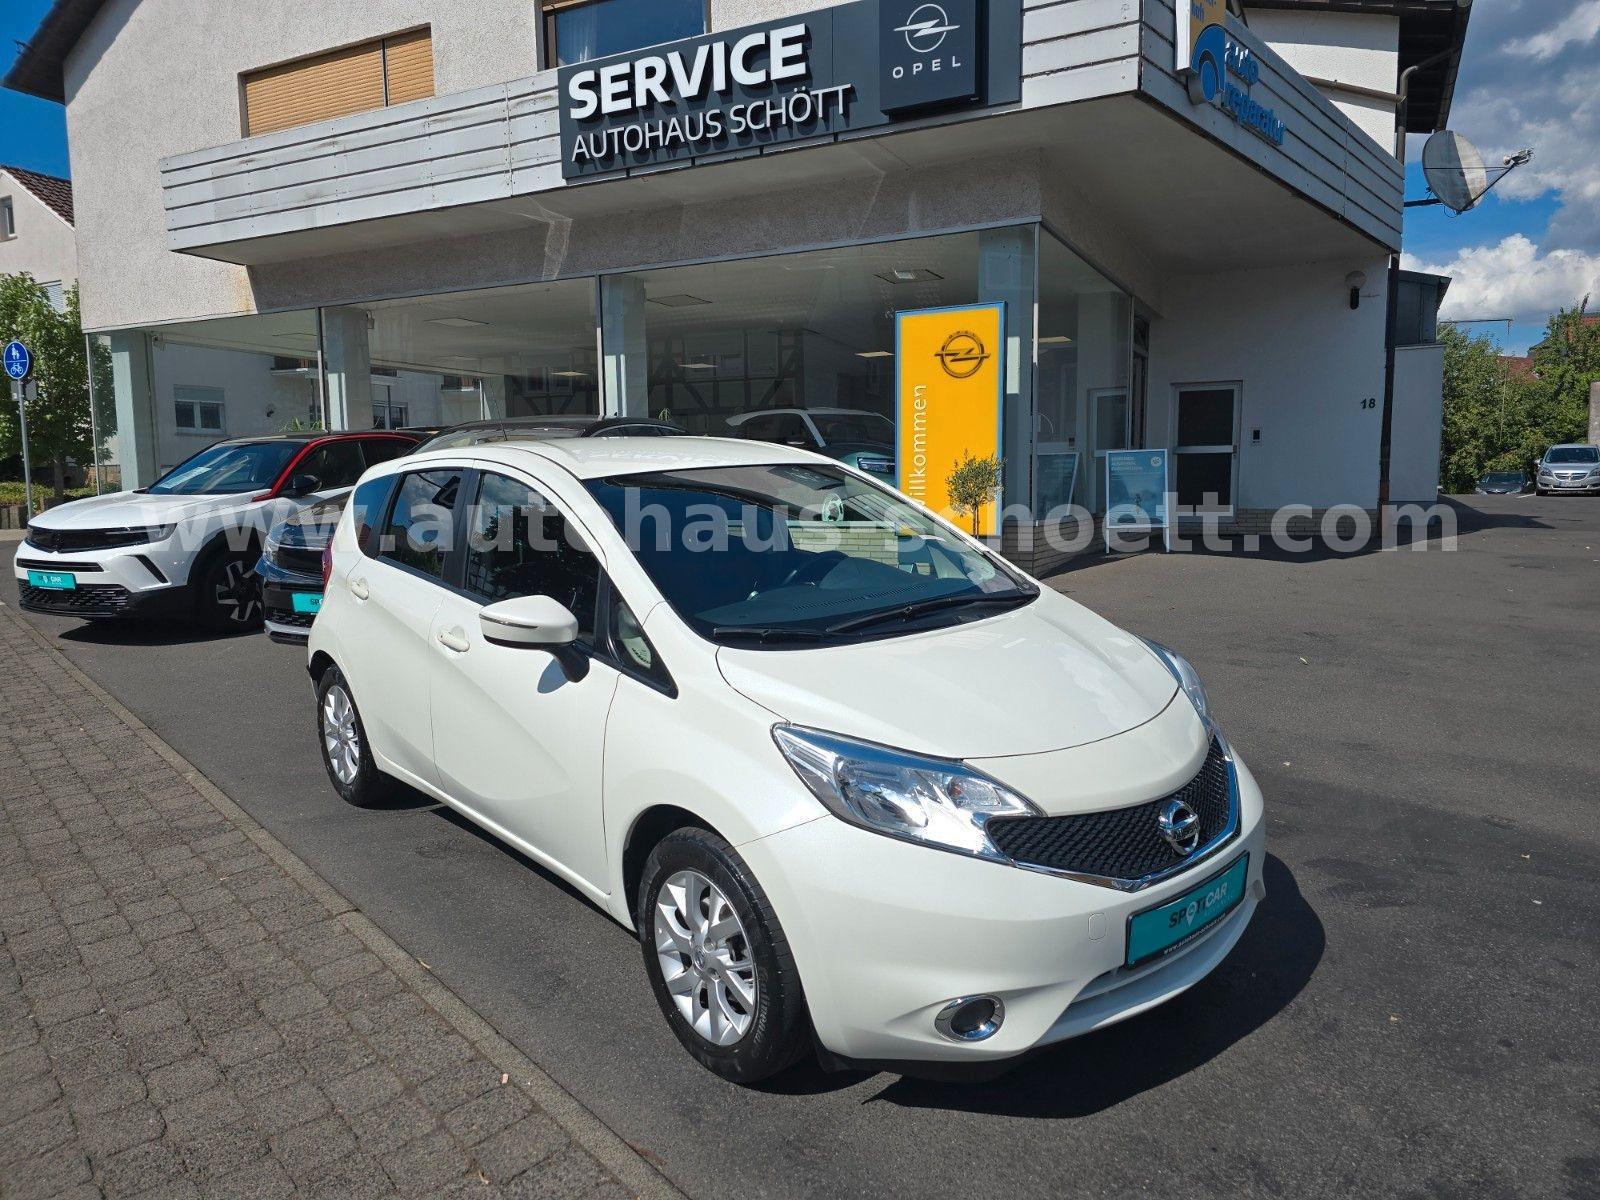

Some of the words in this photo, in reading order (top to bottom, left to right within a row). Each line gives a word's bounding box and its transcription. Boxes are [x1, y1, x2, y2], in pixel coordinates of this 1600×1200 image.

[569, 23, 806, 120] SERVICE
[893, 56, 961, 79] OPEL
[571, 108, 720, 162] AUTOHAUS
[730, 83, 853, 134] SCHÖTT
[1361, 398, 1376, 409] 18
